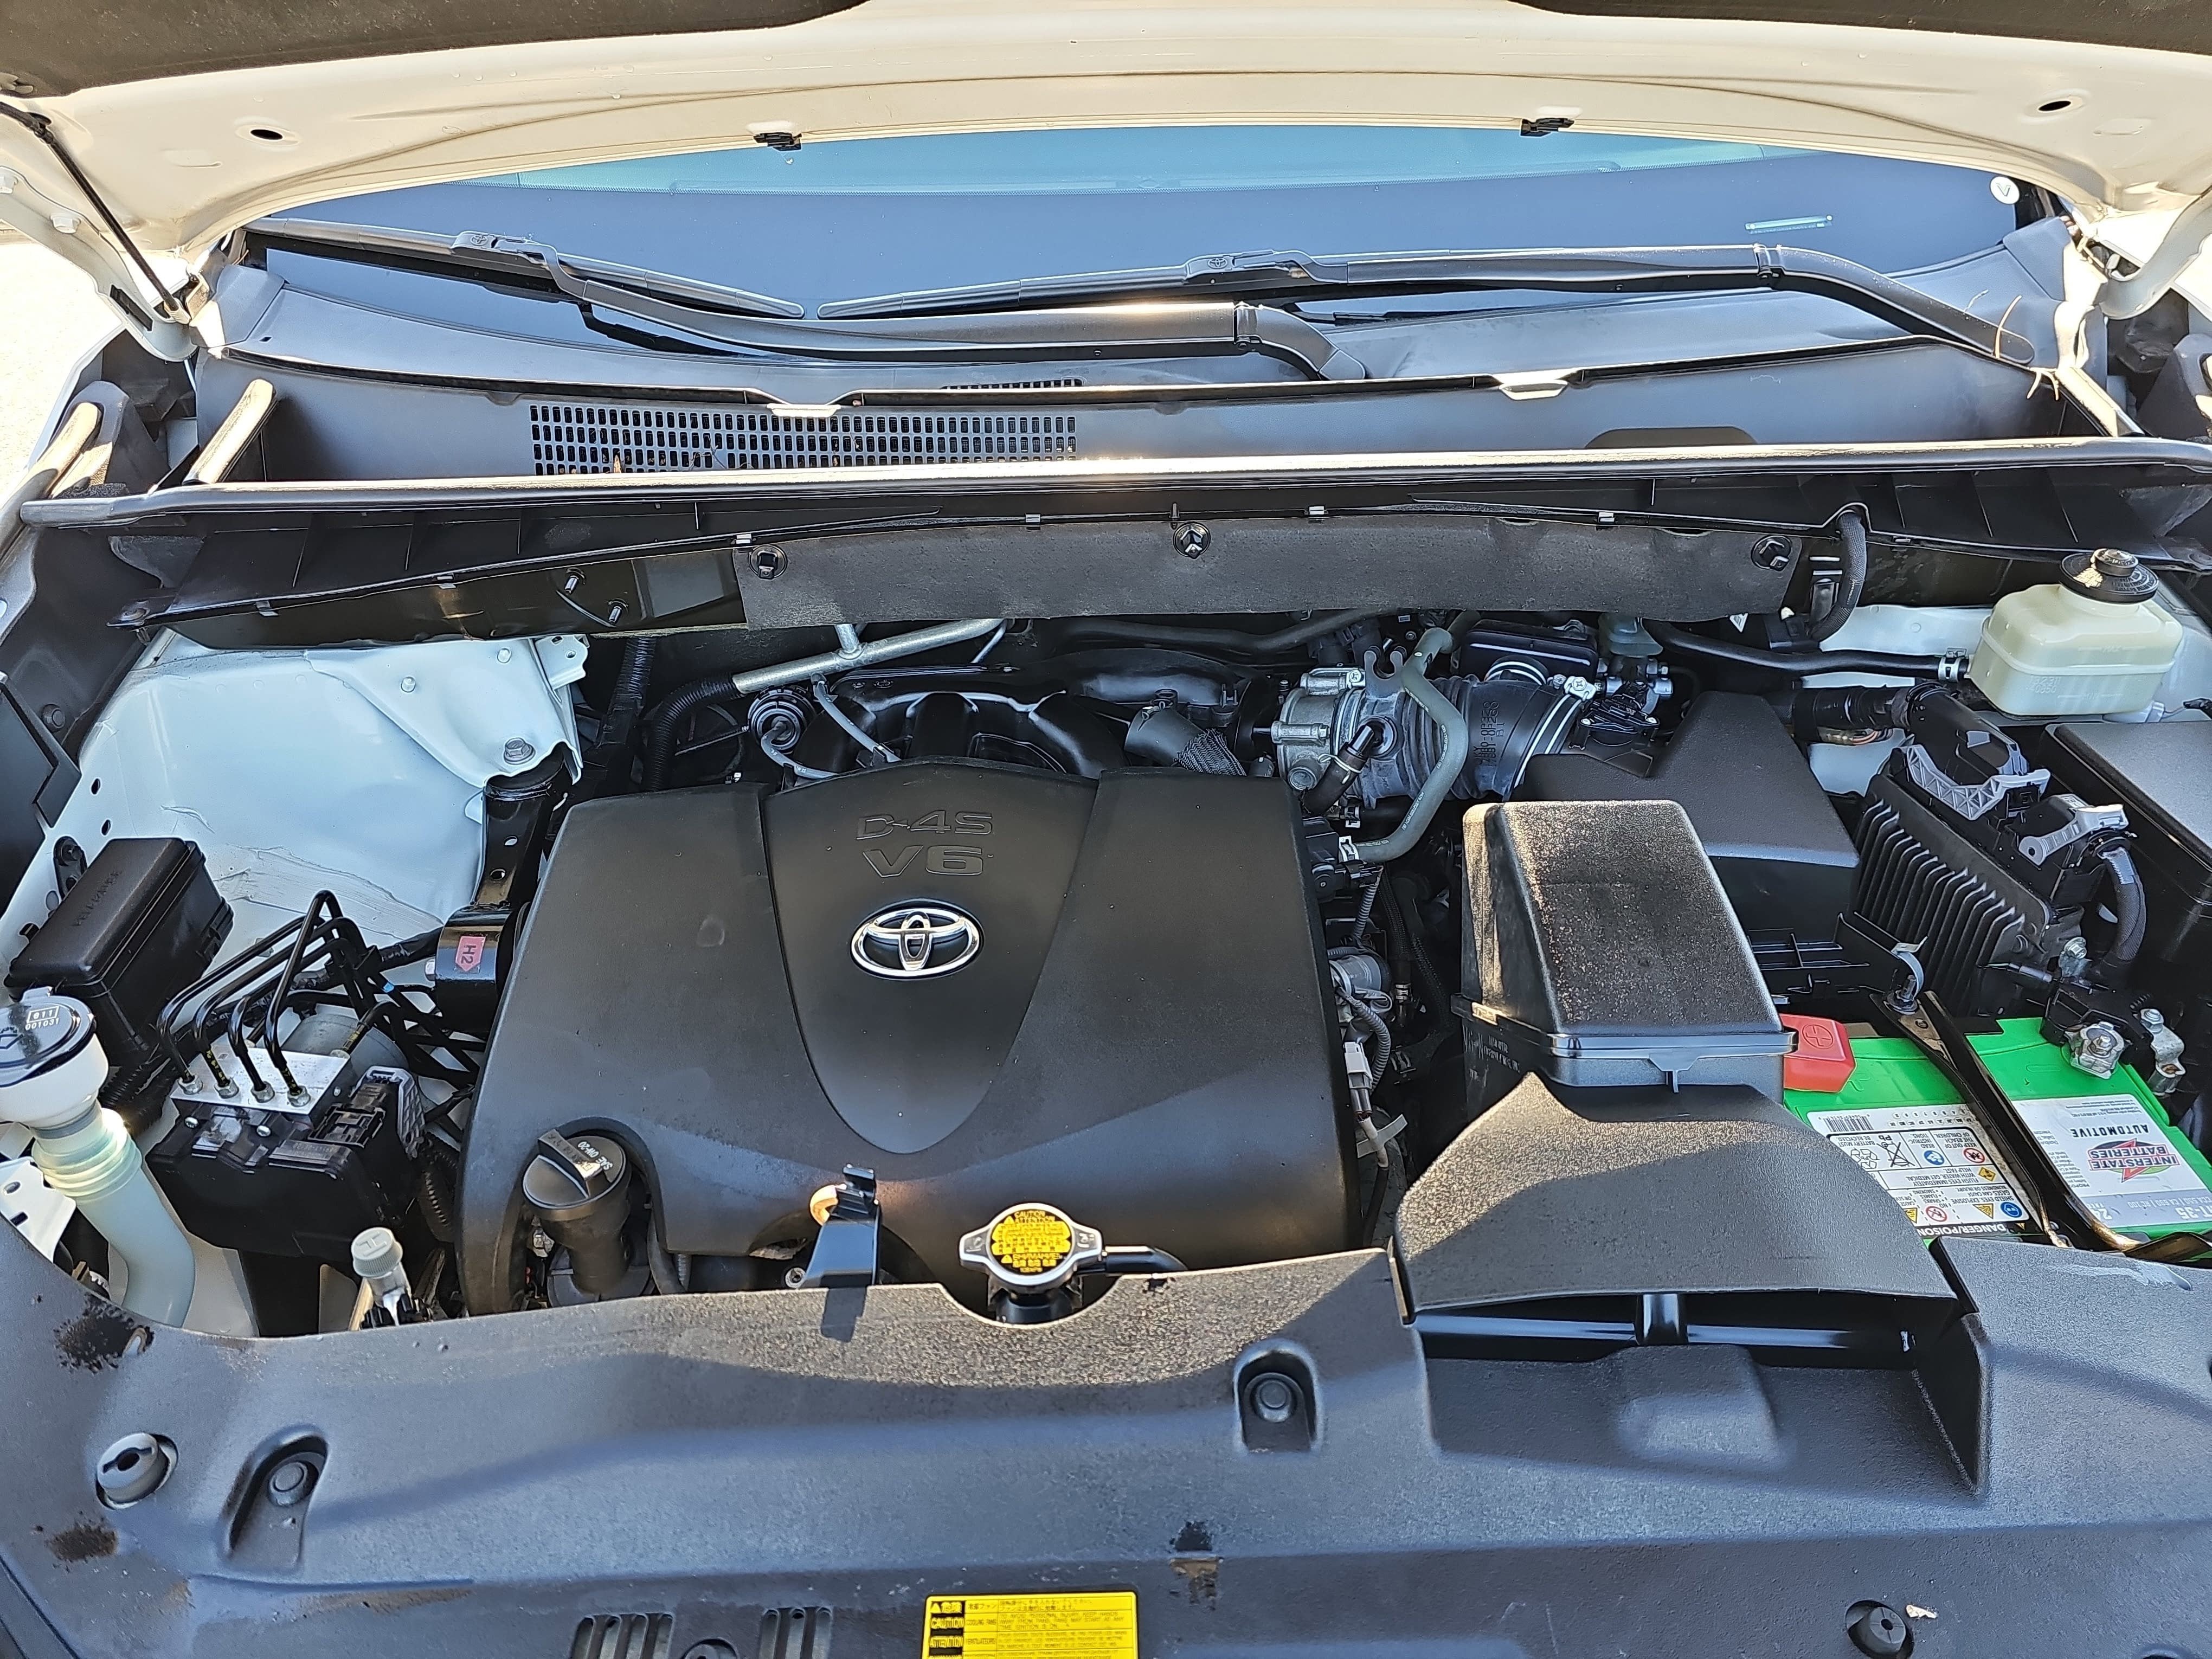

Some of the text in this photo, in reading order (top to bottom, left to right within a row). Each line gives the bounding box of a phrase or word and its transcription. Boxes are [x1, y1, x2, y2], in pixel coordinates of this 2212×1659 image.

[856, 809, 993, 840] D-4S
[862, 845, 983, 878] V6
[461, 945, 476, 964] H2
[2070, 1124, 2148, 1138] AUTOMOTIVE
[577, 1141, 613, 1171] SAE 0W-20
[2089, 1145, 2166, 1158] BATTERIES
[2090, 1155, 2177, 1169] INTERSTATE
[1916, 1224, 2006, 1236] DANGER/POISON
[931, 1617, 964, 1629] CAUTION
[930, 1636, 963, 1648] ATTENTION
